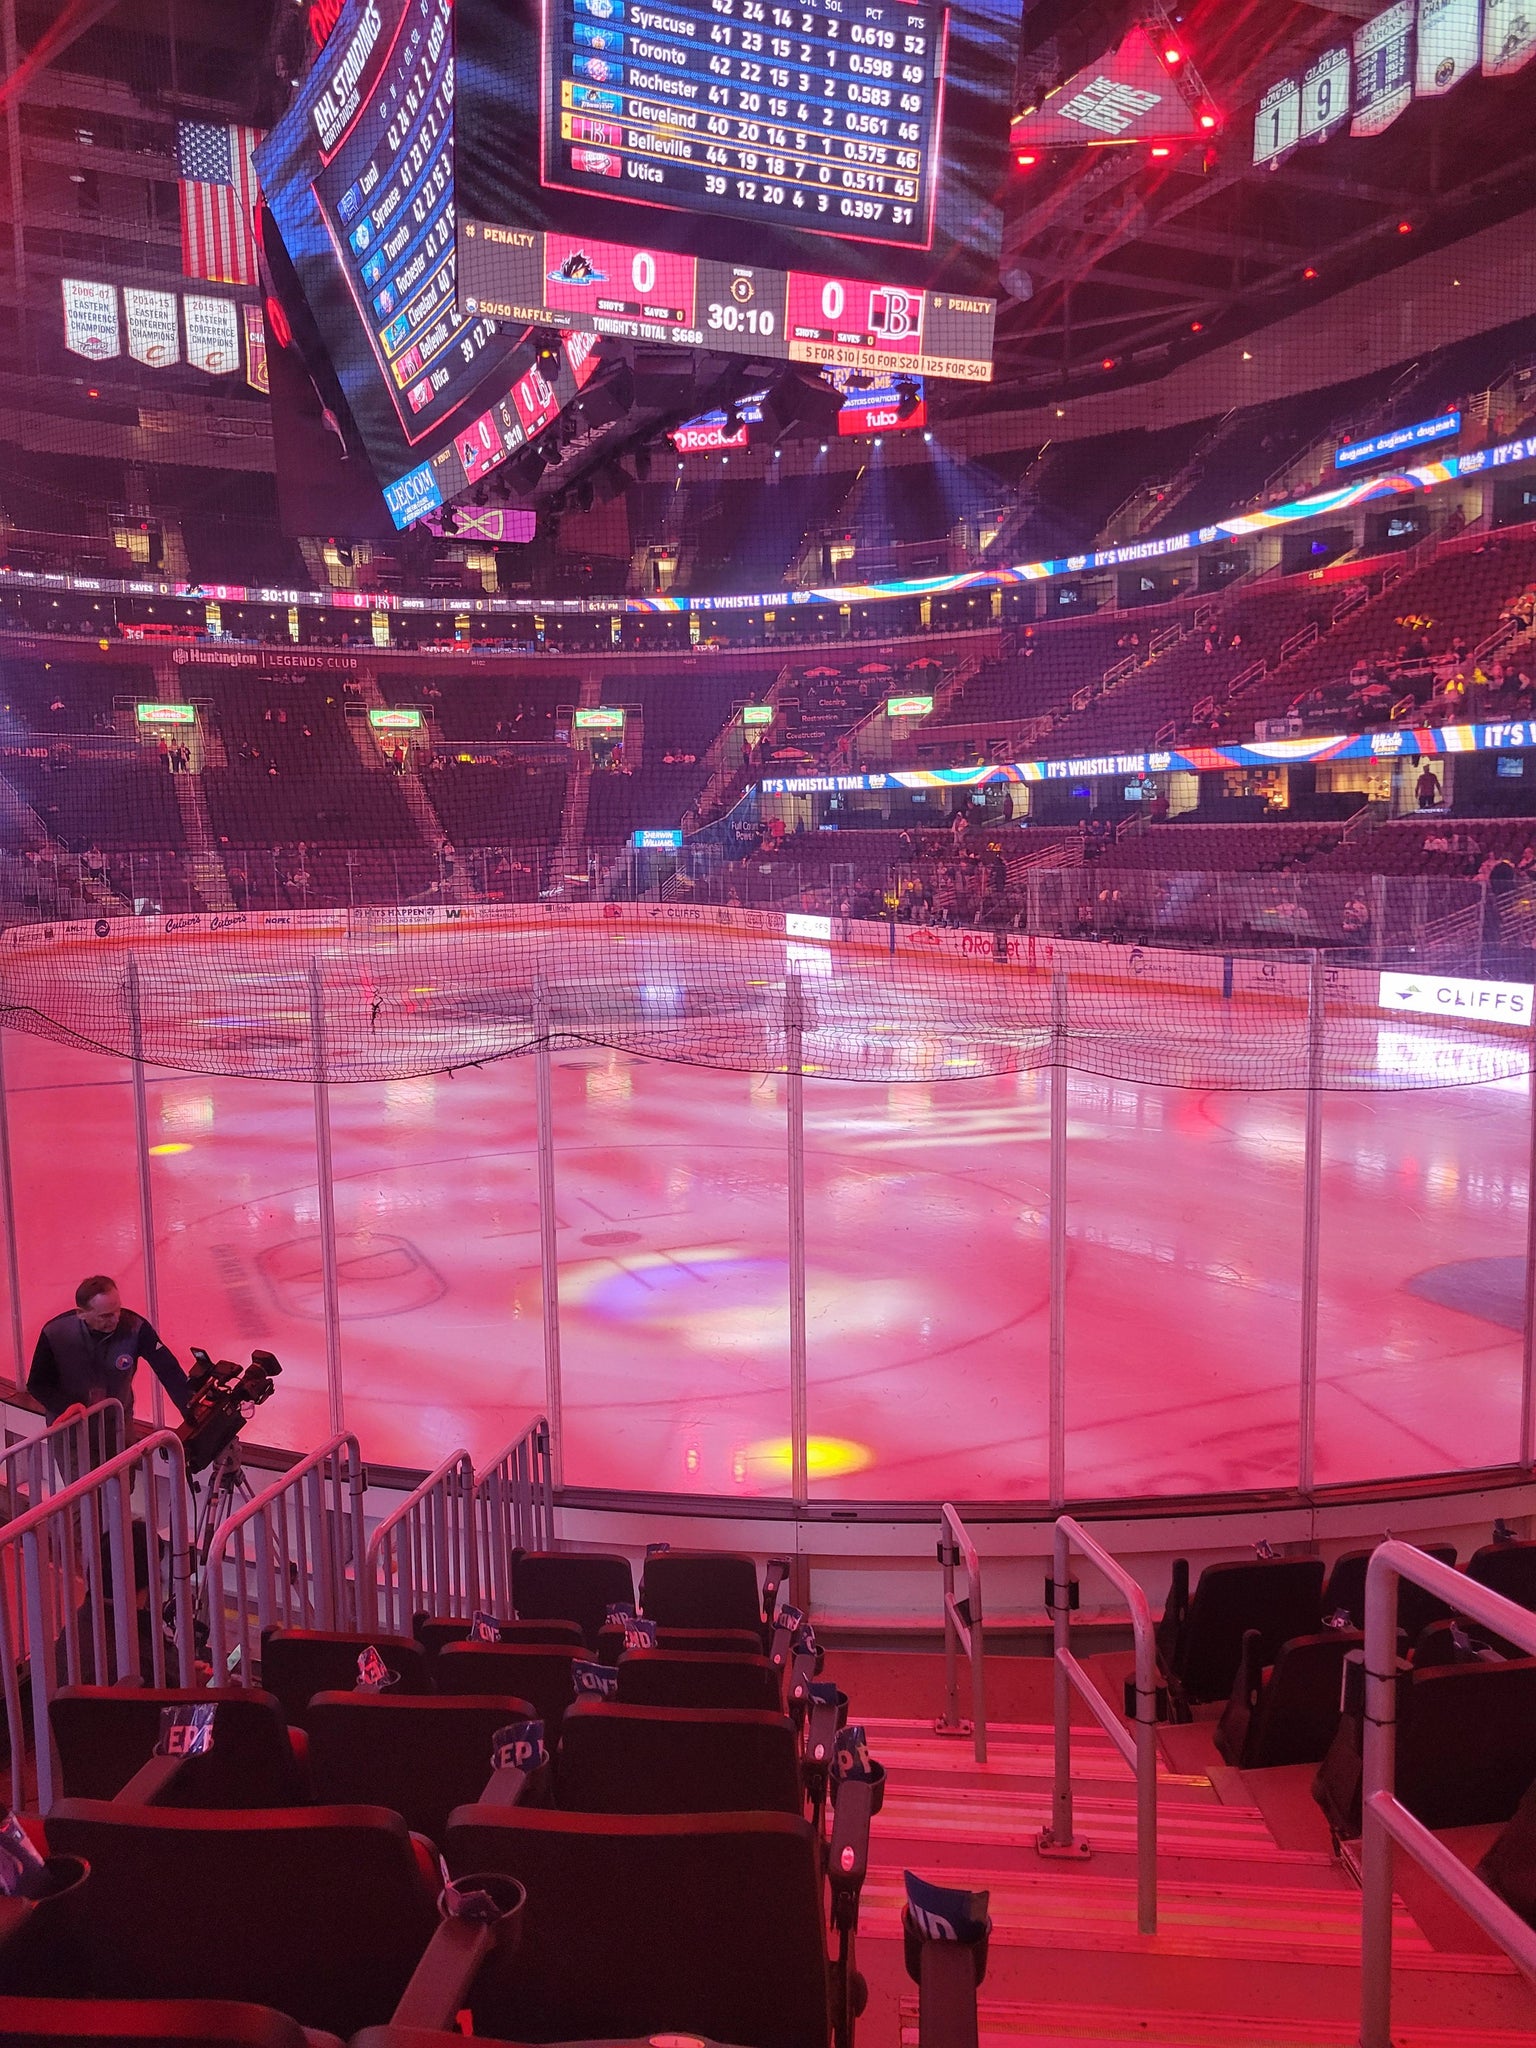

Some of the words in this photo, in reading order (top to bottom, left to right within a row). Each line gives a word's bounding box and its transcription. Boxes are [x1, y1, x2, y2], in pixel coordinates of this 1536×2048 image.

[825, 1, 843, 13] SOL
[866, 7, 883, 20] PCT
[908, 16, 925, 29] PTS
[711, 0, 733, 15] 42
[743, 2, 765, 21] 24
[773, 8, 792, 28] 14
[802, 14, 813, 32] 2
[827, 20, 839, 38] 2
[851, 25, 895, 49] 0.619
[904, 35, 925, 55] 52
[630, 6, 695, 37] Syracuse
[711, 25, 731, 45] 41
[742, 31, 762, 51] 23
[771, 38, 791, 57] 15
[801, 45, 812, 62] 2
[827, 51, 835, 67] 1
[850, 55, 893, 78] 0.598
[902, 65, 924, 84] 49
[313, 91, 340, 138] AHL
[332, 0, 381, 107] STANDINGS
[630, 38, 686, 66] Toronto
[709, 56, 731, 75] 42
[740, 62, 761, 82] 22
[770, 69, 789, 87] 15
[799, 74, 809, 91] 3
[824, 80, 835, 97] 2
[848, 84, 890, 107] 0.583
[900, 94, 921, 112] 49
[1305, 47, 1348, 82] GLOVER
[629, 69, 698, 99] Rochester
[708, 85, 728, 105] 41
[739, 92, 760, 111] 20
[768, 98, 788, 116] 15
[797, 104, 809, 121] 4
[823, 109, 834, 125] 2
[846, 115, 888, 135] 0.561
[899, 123, 919, 141] 46
[1057, 94, 1099, 121] FEAR
[1083, 75, 1120, 98] THE
[1260, 80, 1296, 108] BOWER
[1317, 78, 1331, 121] 9
[1078, 84, 1162, 135] DEPTHS
[629, 100, 697, 129] Cleveland
[707, 116, 729, 136] 40
[738, 122, 759, 141] 20
[767, 128, 786, 147] 14
[796, 134, 806, 150] 5
[822, 139, 831, 155] 1
[844, 142, 887, 164] 0.575
[896, 151, 917, 169] 46
[1271, 107, 1281, 149] 1
[628, 131, 692, 158] Belleville
[706, 146, 728, 166] 44
[738, 152, 757, 171] 19
[765, 157, 785, 176] 18
[795, 163, 805, 179] 7
[819, 166, 831, 183] 0
[842, 171, 884, 193] 0.511
[894, 180, 914, 197] 45
[360, 161, 379, 195] Laval
[627, 161, 664, 183] Utica
[705, 174, 727, 194] 39
[737, 181, 756, 200] 12
[763, 186, 784, 204] 20
[793, 191, 804, 208] 4
[818, 195, 829, 212] 3
[840, 199, 884, 221] 0.397
[892, 207, 913, 225] 31
[372, 187, 400, 229] Syracuse
[383, 225, 410, 261] Toronto
[484, 228, 534, 248] PENALTY
[396, 253, 426, 295] Rochester
[632, 252, 655, 293] 0
[72, 285, 110, 299] 2006-07
[738, 285, 746, 295] 3
[821, 282, 844, 319] 0
[74, 300, 110, 311] EASTERN
[133, 295, 170, 309] 2014-15
[408, 284, 438, 327] Cleveland
[480, 301, 511, 317] 50/50
[513, 307, 553, 323] RAFFLE
[598, 300, 624, 312] SHOTS
[644, 307, 669, 318] SAVES
[948, 299, 992, 314] PENALTY
[69, 309, 117, 324] CONFERENCE
[130, 317, 176, 332] CONFERENCE
[135, 309, 169, 320] EASTERN
[195, 314, 228, 326] EASTERN
[707, 303, 775, 336] 30:10
[71, 321, 116, 335] CHAMPIONS
[132, 329, 175, 342] CHAMPIONS
[189, 324, 235, 338] CONFERENCE
[593, 317, 638, 337] TONIGHT'S
[640, 325, 666, 340] TOTAL
[795, 328, 820, 339] SHOTS
[837, 333, 860, 344] SAVES
[192, 335, 234, 349] CHAMPIONS
[419, 323, 449, 360] Belleville
[806, 346, 813, 358] 5
[815, 347, 834, 360] FOR
[837, 348, 855, 363] $10
[861, 353, 875, 365] 50
[877, 355, 897, 369] FOR
[899, 357, 919, 370] $20
[927, 360, 943, 373] 125
[946, 362, 966, 375] FOR
[967, 364, 987, 378] $40
[430, 368, 450, 391] Utica
[866, 411, 898, 427] fubo
[1493, 440, 1524, 465] IT'S
[1095, 551, 1116, 567] IT'S
[1116, 539, 1165, 562] WHISTLE
[1166, 534, 1190, 552] TIME
[74, 580, 99, 588] SHOTS
[130, 583, 153, 592] SAVES
[261, 590, 297, 602] 30:10
[402, 600, 424, 608] SHOTS
[450, 601, 470, 609] SAVES
[589, 602, 606, 611] 6:14
[690, 597, 711, 610] IT'S
[714, 594, 760, 609] WHISTLE
[763, 593, 787, 606] TIME
[190, 649, 257, 667] Huntington
[269, 655, 323, 667] LEGENDS
[327, 657, 358, 668] CLUB
[1485, 724, 1524, 746] IT'S
[1047, 761, 1067, 778] IT'S
[1069, 757, 1115, 776] WHISTLE
[1116, 755, 1144, 773] TIME
[762, 780, 784, 792] IT'S
[785, 777, 835, 792] WHISTLE
[837, 776, 864, 790] TIME
[736, 832, 754, 841] Power
[388, 907, 424, 917] HAPPEN
[667, 908, 700, 919] CLIFFS
[165, 914, 202, 933] Culver's
[210, 914, 247, 930] Culver's
[1437, 988, 1524, 1012] CLIFFS
